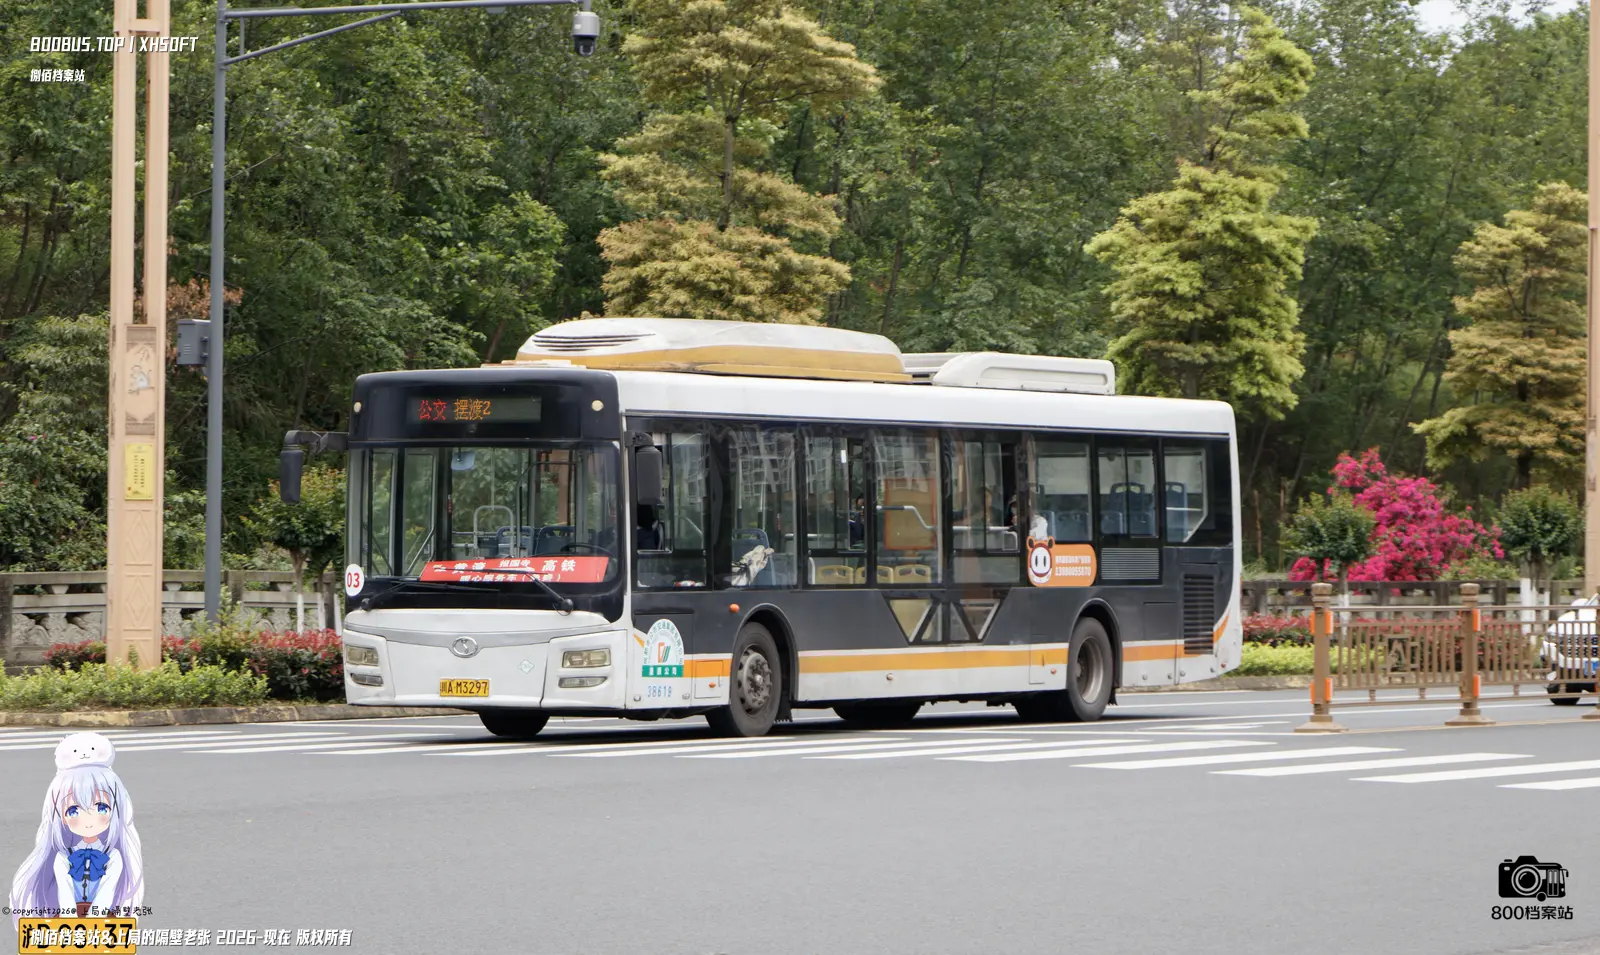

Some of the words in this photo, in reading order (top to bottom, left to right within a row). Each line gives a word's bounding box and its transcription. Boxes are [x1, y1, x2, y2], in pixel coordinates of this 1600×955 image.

[418, 399, 447, 421] 公交
[454, 398, 491, 421] 摆渡2
[541, 559, 576, 572] 高铁
[346, 572, 360, 588] 03
[647, 685, 673, 698] 38619
